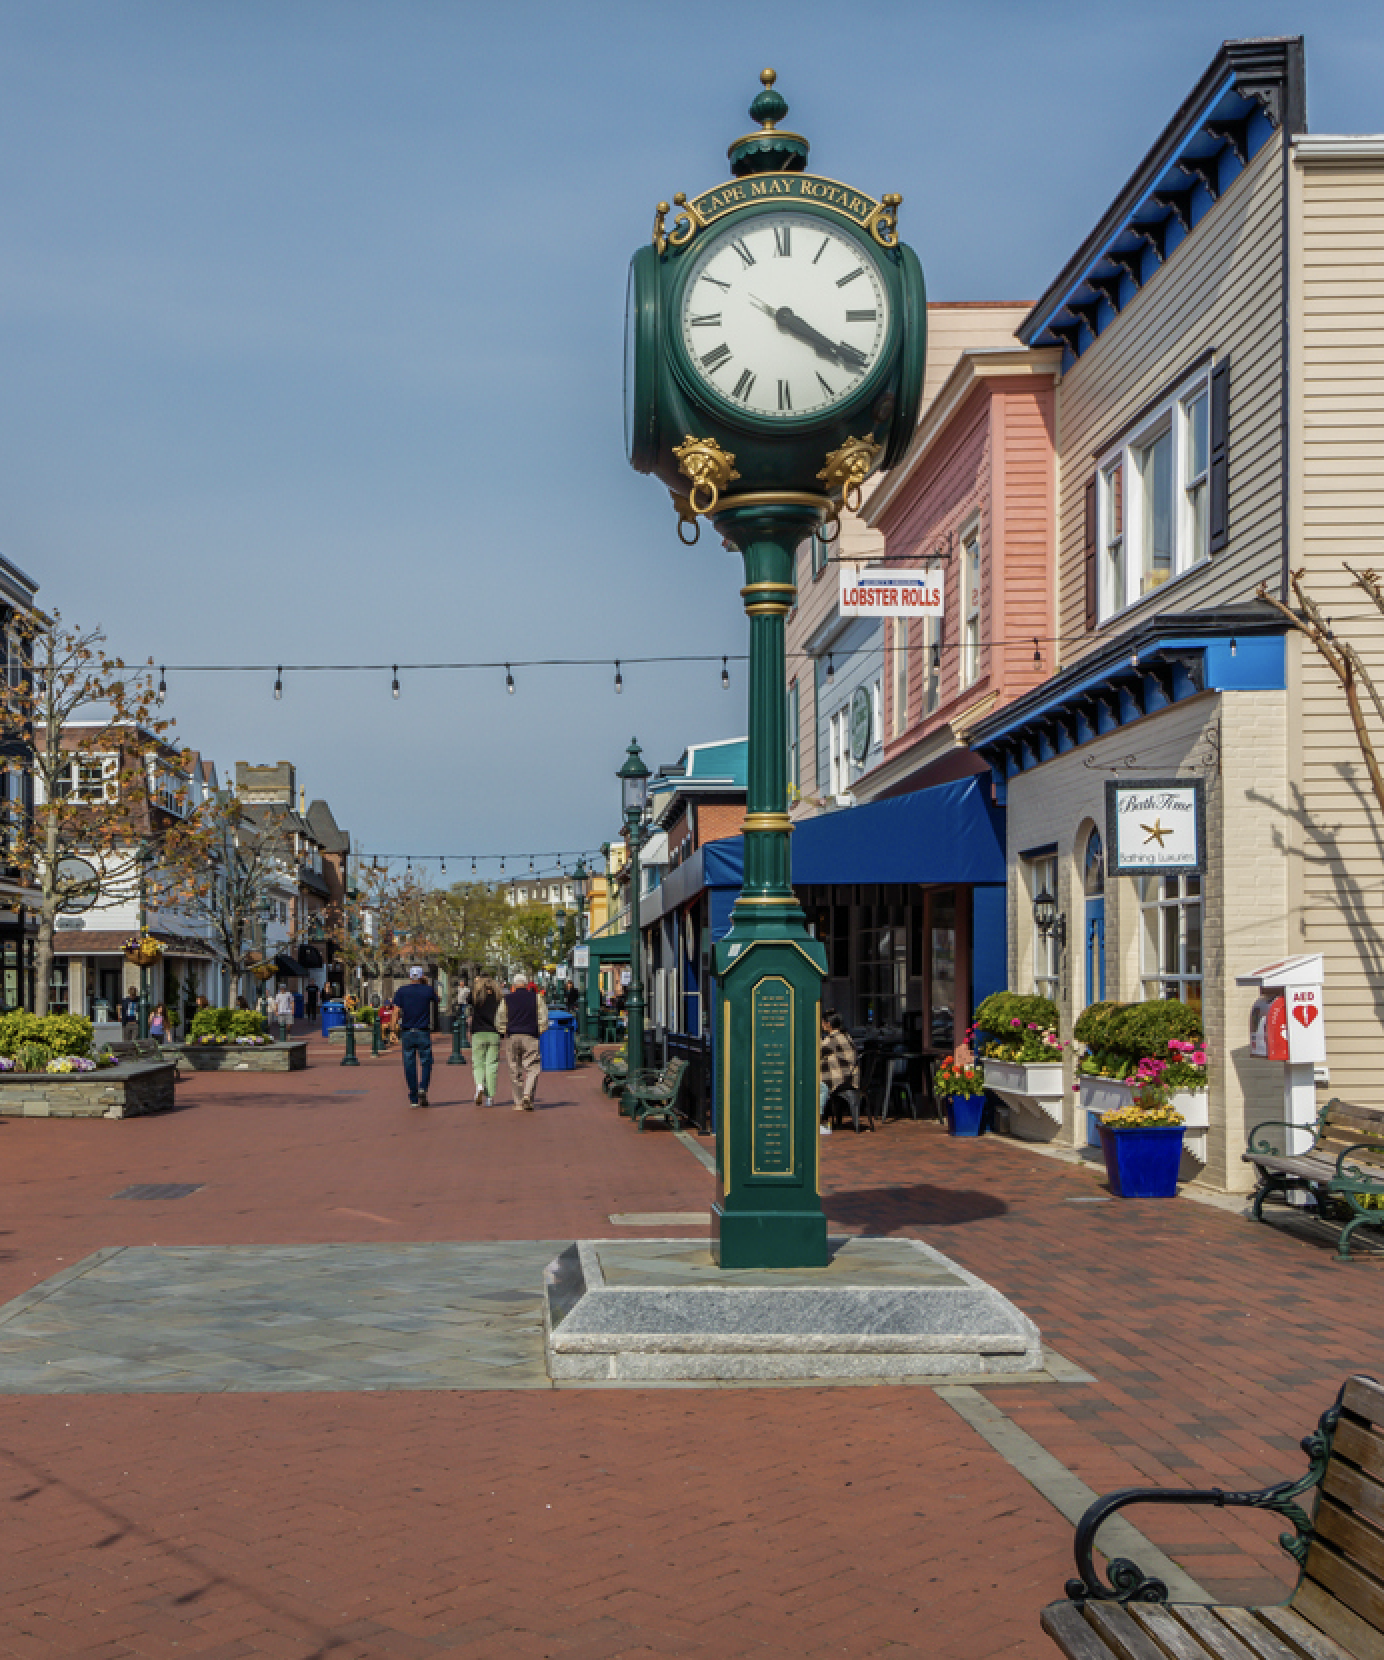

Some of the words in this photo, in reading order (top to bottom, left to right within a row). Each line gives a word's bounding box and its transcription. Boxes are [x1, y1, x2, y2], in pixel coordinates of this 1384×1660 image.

[696, 185, 746, 215] CAPE
[750, 179, 795, 197] MAY
[800, 179, 875, 216] ROTARY
[843, 588, 898, 607] LOBSTER
[902, 588, 940, 607] ROLLS
[1119, 793, 1156, 814] Bath
[1293, 991, 1315, 1002] AED
